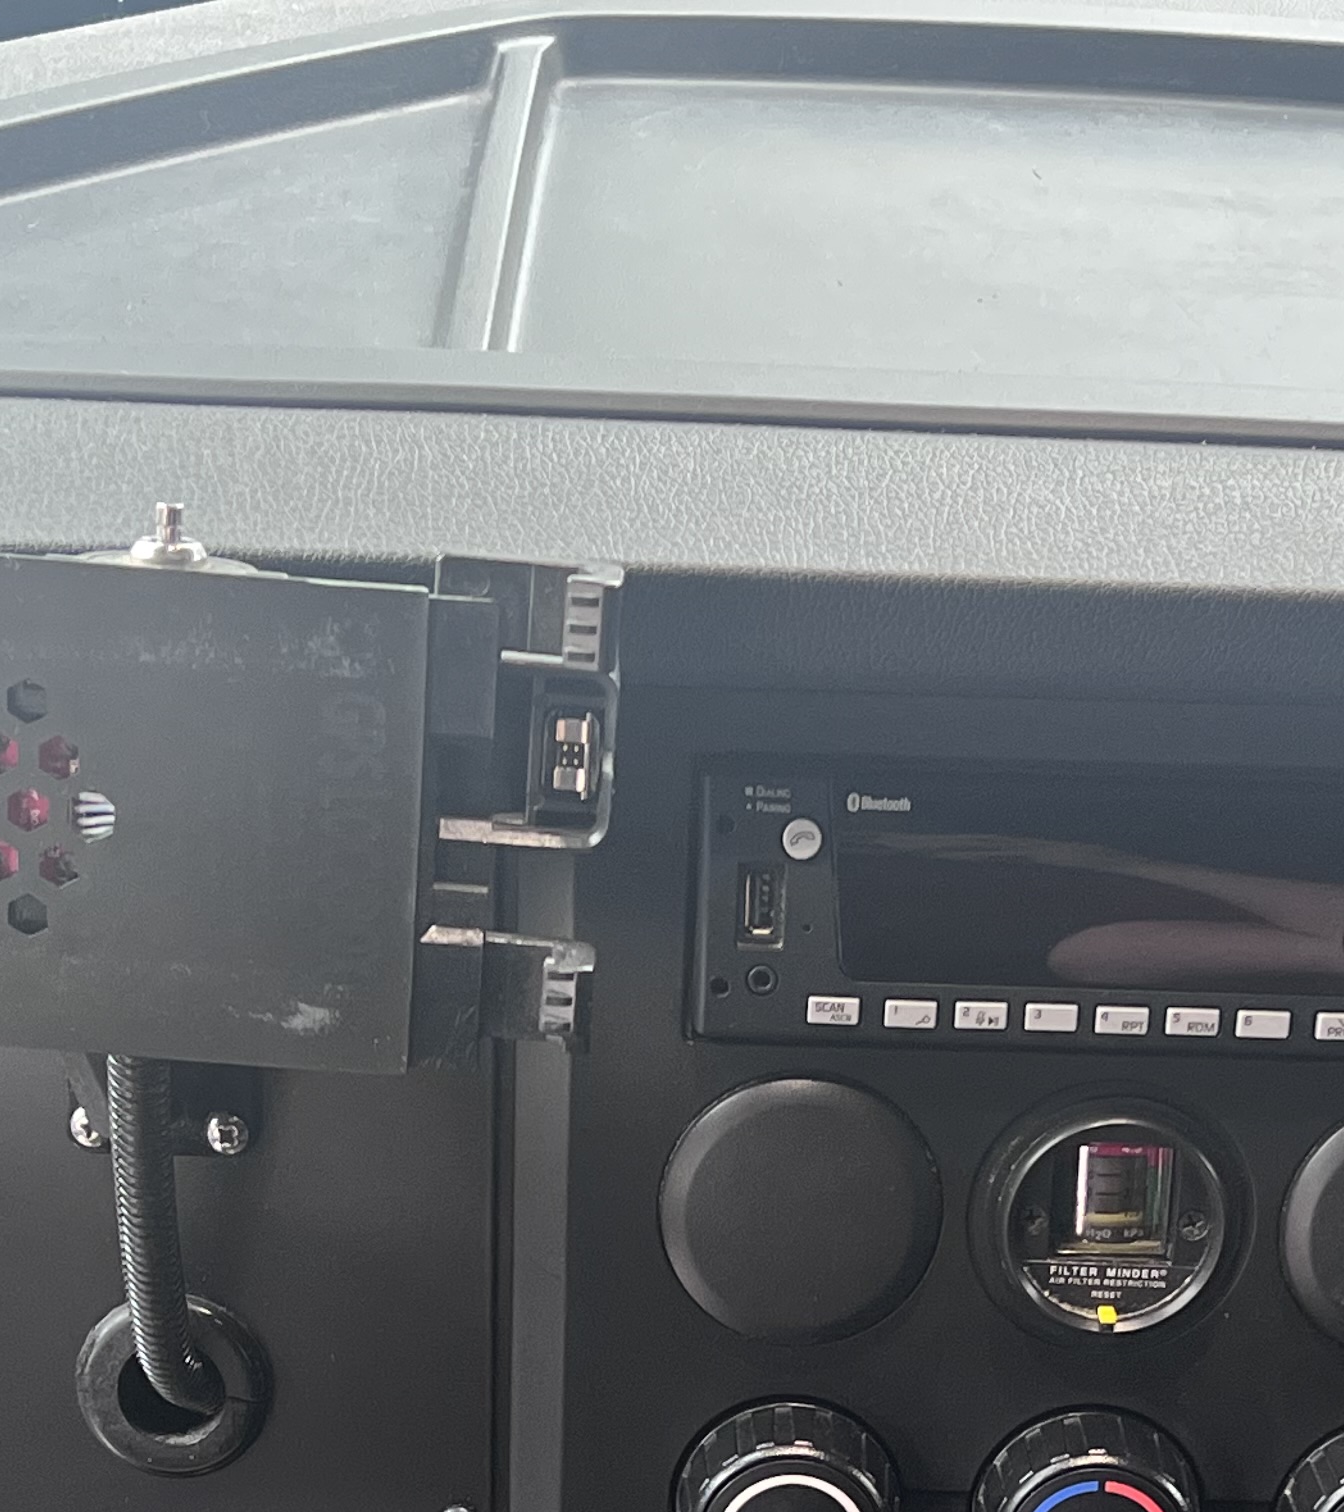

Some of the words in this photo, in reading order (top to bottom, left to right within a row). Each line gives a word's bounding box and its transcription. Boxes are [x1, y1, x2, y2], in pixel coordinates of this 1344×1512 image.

[862, 796, 911, 811] Bluetooth
[815, 1002, 845, 1013] SCAN
[962, 1007, 970, 1017] 2
[1034, 1009, 1042, 1019] 3
[1173, 1013, 1180, 1024] 5
[1244, 1015, 1253, 1025] 6
[1121, 1021, 1144, 1032] RPT
[1187, 1022, 1215, 1033] RDM
[1049, 1265, 1098, 1276] FILTER
[1068, 1278, 1101, 1286] FILTER
[1103, 1279, 1166, 1288] RESTRICTION
[1091, 1290, 1122, 1299] RESET
